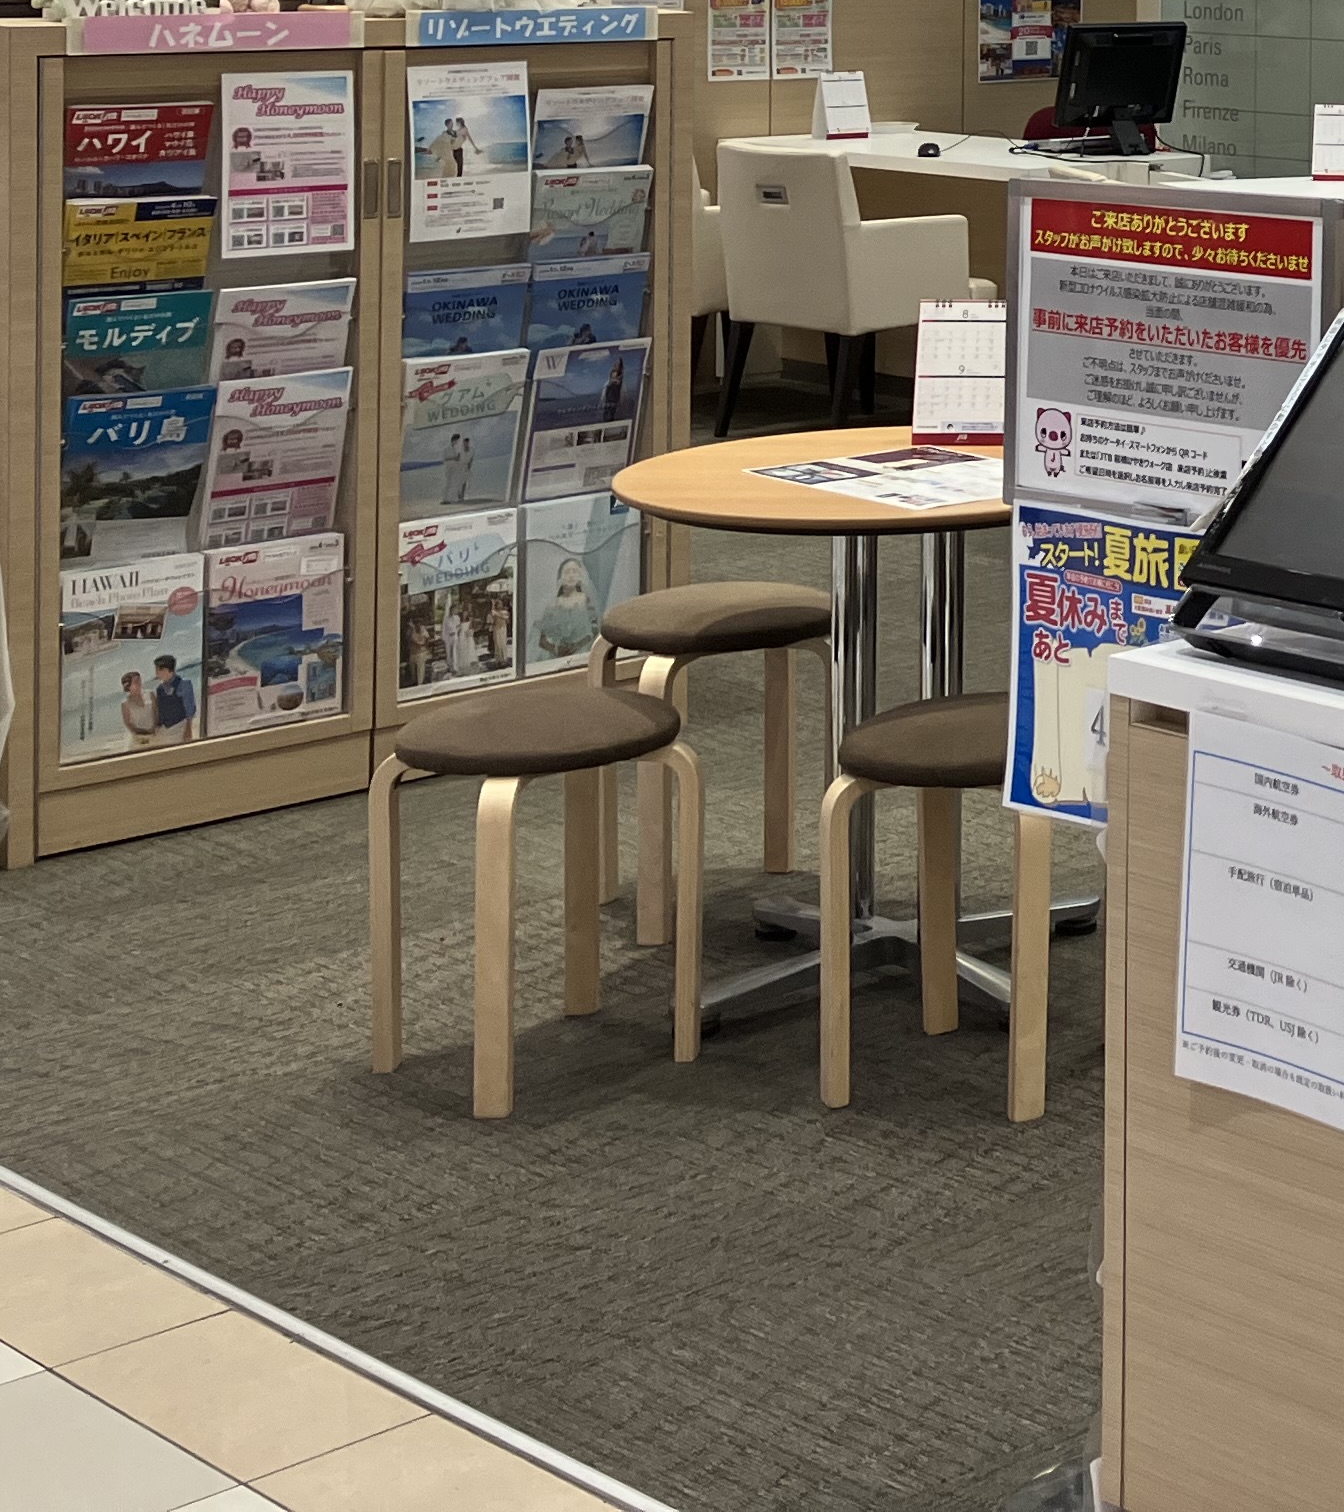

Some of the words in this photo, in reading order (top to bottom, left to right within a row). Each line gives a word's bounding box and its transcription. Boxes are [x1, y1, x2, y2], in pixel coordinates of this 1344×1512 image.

[1183, 0, 1245, 21] London
[149, 19, 290, 49] ハネムーン
[427, 12, 642, 41] リゾートウエディング
[1183, 35, 1222, 56] Paris
[1182, 67, 1229, 88] Roma
[232, 84, 286, 104] Happy
[256, 100, 345, 119] Honeymoon
[1183, 99, 1240, 122] Firenze
[76, 130, 153, 154] ハワイ
[1182, 134, 1238, 157] Milano
[1091, 209, 1250, 243] ご来店ありがとうございます
[1034, 229, 1310, 274] スタッフがお声がけ致しますので、少々お待ちくださいませ
[557, 284, 620, 300] OKINAWA
[231, 298, 287, 316] Happy
[432, 295, 499, 314] OKINAWA
[557, 297, 619, 312] WEDDING
[252, 309, 343, 328] Honeymoon
[431, 308, 497, 326] WEDDING
[76, 316, 200, 351] モルディブ
[1032, 307, 1308, 361] 事前に来店予約をいただいたお客様を優先
[228, 386, 285, 404] Happy
[250, 396, 343, 418] Honeymoon
[427, 401, 496, 423] WEDDING
[86, 414, 188, 446] バリ島
[1040, 541, 1100, 568] スタート!
[1102, 525, 1170, 588] 夏旅
[422, 564, 490, 587] WEDDING
[219, 574, 333, 603] Honeymoon
[1024, 571, 1109, 636] 夏休み
[1108, 598, 1128, 647] まで
[1031, 628, 1073, 666] あと
